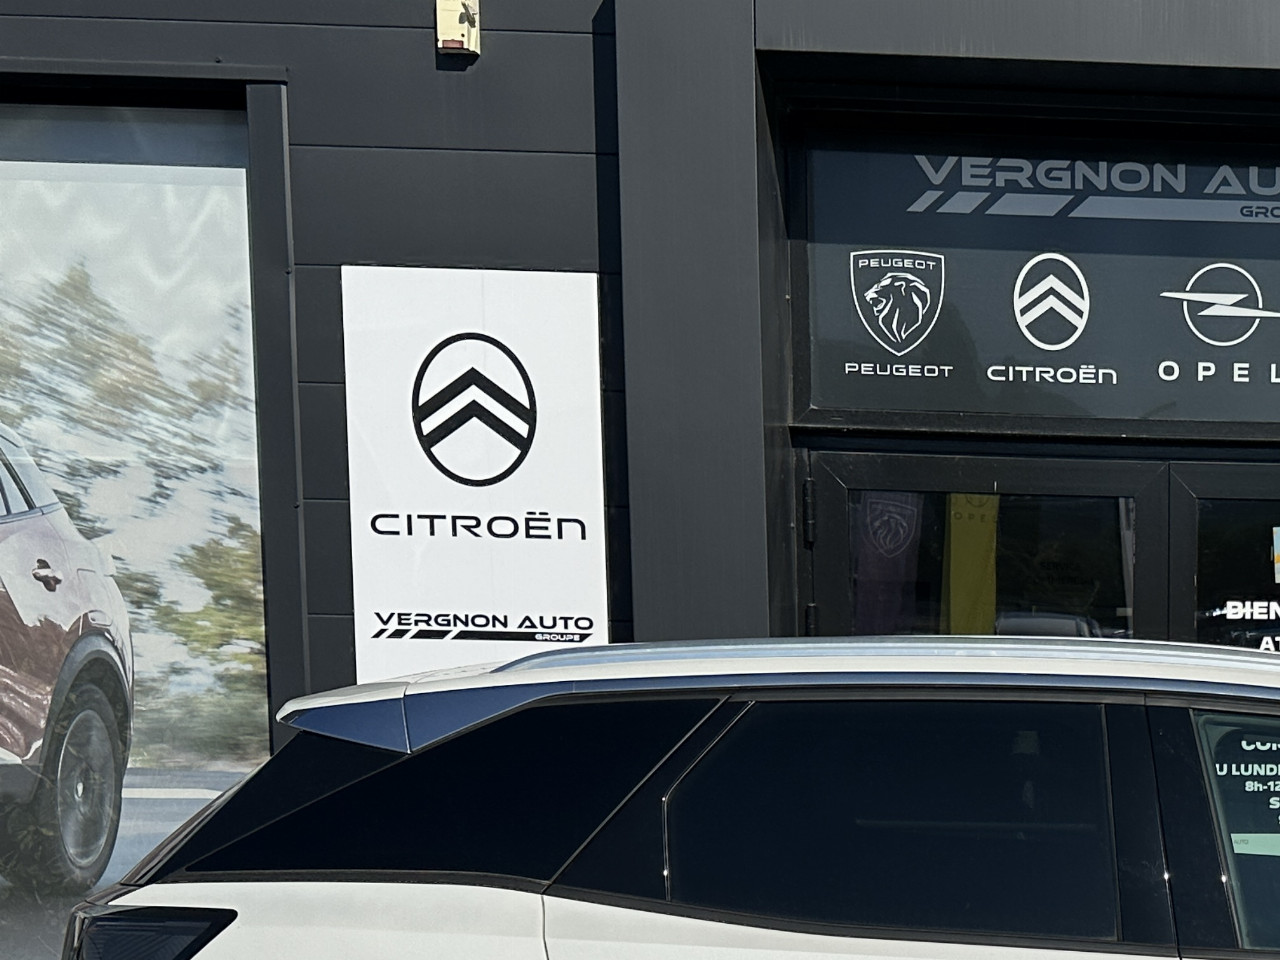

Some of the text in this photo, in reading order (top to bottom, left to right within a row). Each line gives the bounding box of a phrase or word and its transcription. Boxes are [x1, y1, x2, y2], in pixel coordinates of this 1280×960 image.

[913, 155, 1187, 194] VERGNON
[858, 257, 937, 271] PEUGEOT
[844, 362, 954, 378] PEUGEOT
[374, 611, 594, 631] VERGNON AUTO
[534, 632, 582, 642] GROUPE
[1216, 763, 1228, 776] U
